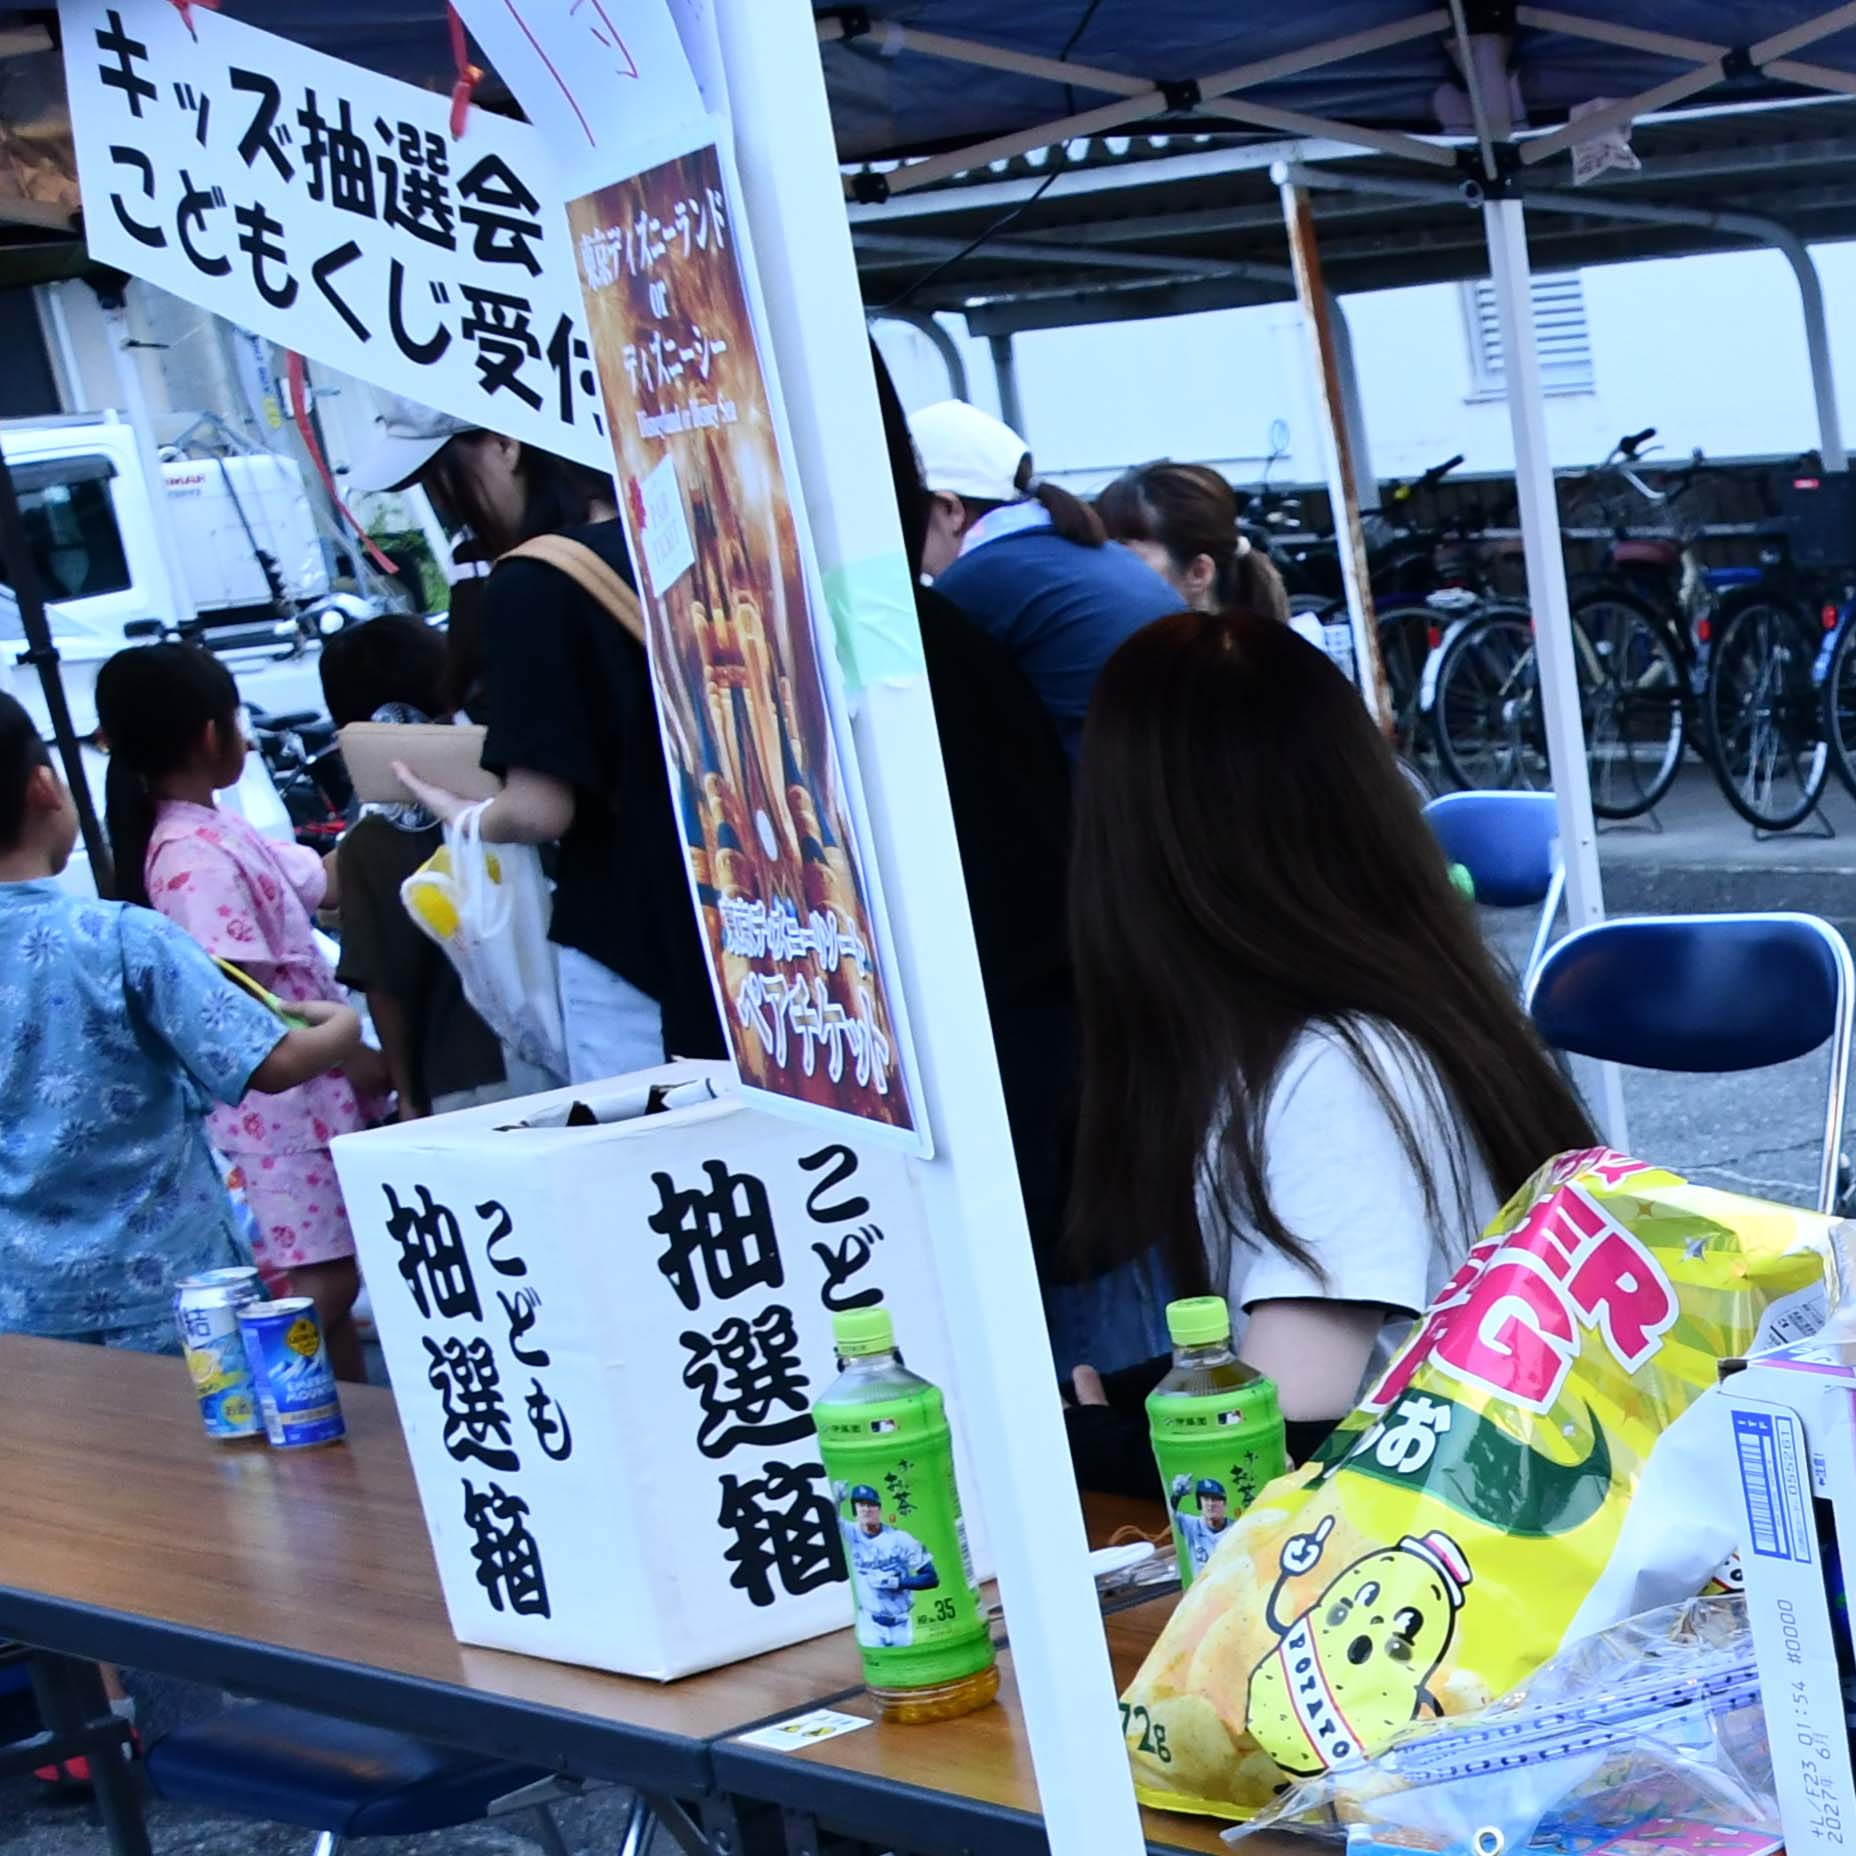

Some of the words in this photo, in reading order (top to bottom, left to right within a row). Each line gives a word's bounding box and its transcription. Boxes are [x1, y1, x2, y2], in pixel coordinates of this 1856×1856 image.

[95, 9, 544, 278] キッズ抽選会
[623, 325, 728, 394] ディズニーシー
[736, 971, 890, 1096] ペアチケット
[476, 1200, 572, 1460] こども
[647, 1159, 852, 1607] 抽選箱
[382, 1183, 551, 1619] 抽選箱
[1781, 1430, 1798, 1496] 055261
[935, 1598, 957, 1621] 35
[1776, 1598, 1802, 1665] #0000
[1288, 1632, 1351, 1759] POTATO
[1790, 1680, 1814, 1747] 01:54
